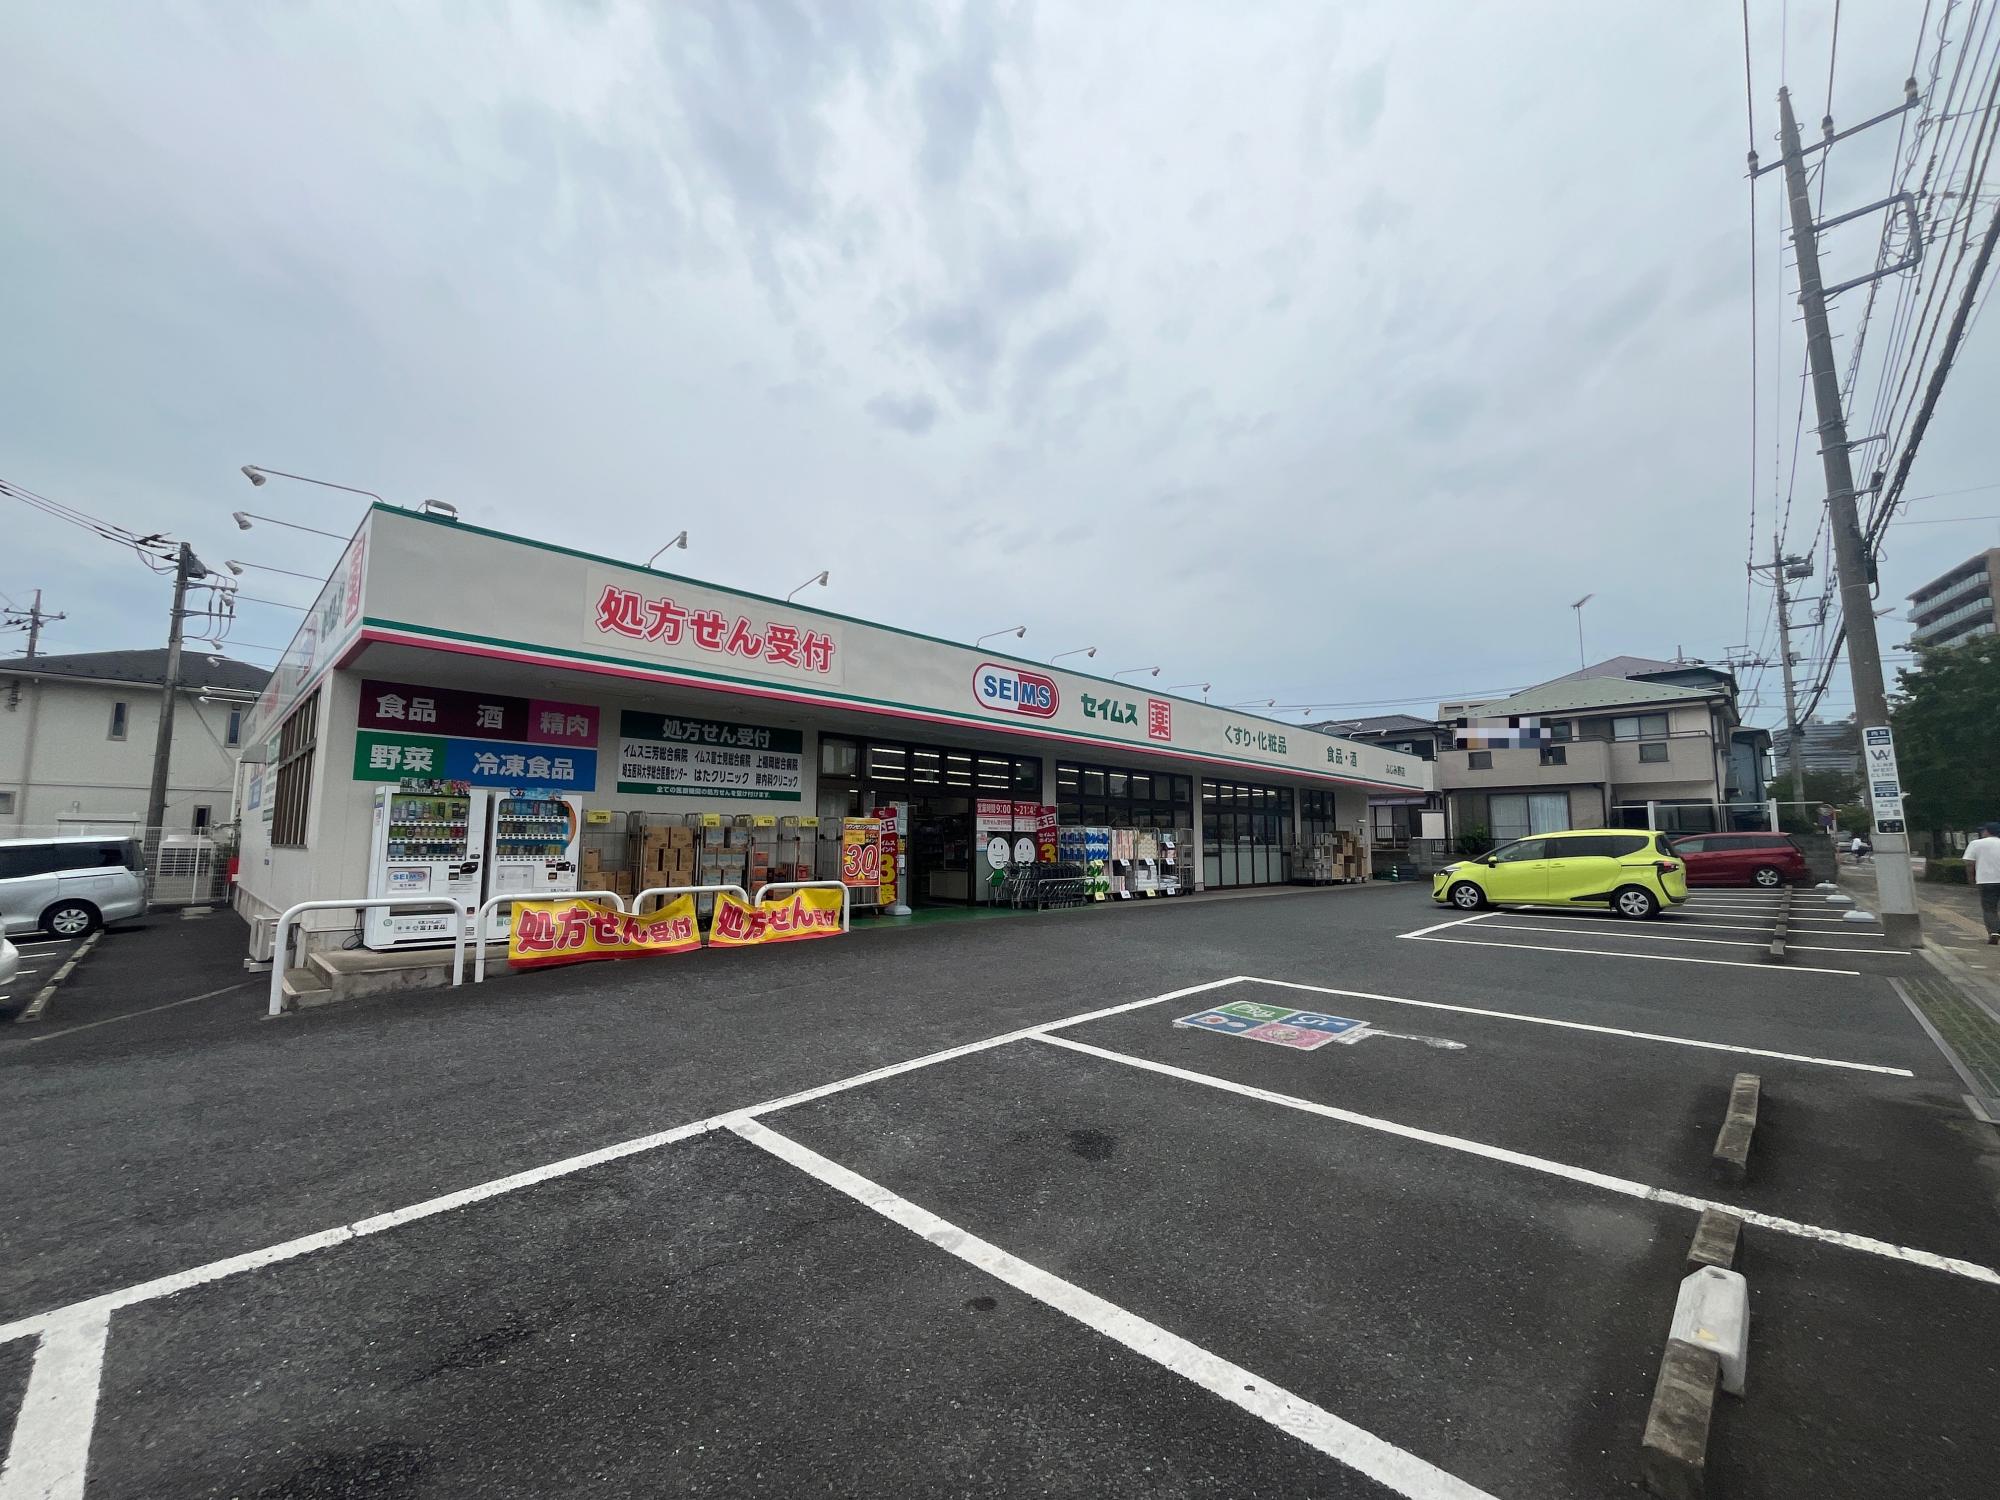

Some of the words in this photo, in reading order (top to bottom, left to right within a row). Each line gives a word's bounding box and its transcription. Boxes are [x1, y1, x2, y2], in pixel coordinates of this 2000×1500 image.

[596, 586, 834, 672] 処方せん受付
[983, 675, 1050, 708] SEIMS
[376, 693, 436, 722] 食品
[476, 704, 504, 729] 酒
[540, 711, 589, 737] 精肉
[1080, 693, 1138, 726] セイムス
[1150, 701, 1170, 738] 薬
[662, 718, 771, 748] 処方せん受付
[1224, 725, 1287, 754] くすり・化粧品
[369, 744, 433, 772] 野菜
[472, 752, 574, 780] 冷凍食品
[623, 744, 688, 763] イムス三芳総合病院
[694, 745, 751, 767] イムス富士見総合病院
[1326, 746, 1357, 768] 食品・酒
[694, 768, 749, 784] はたクリニック
[844, 845, 878, 876] 30
[517, 908, 692, 954] 処方せん受付
[717, 896, 836, 941] 処方せん受付
